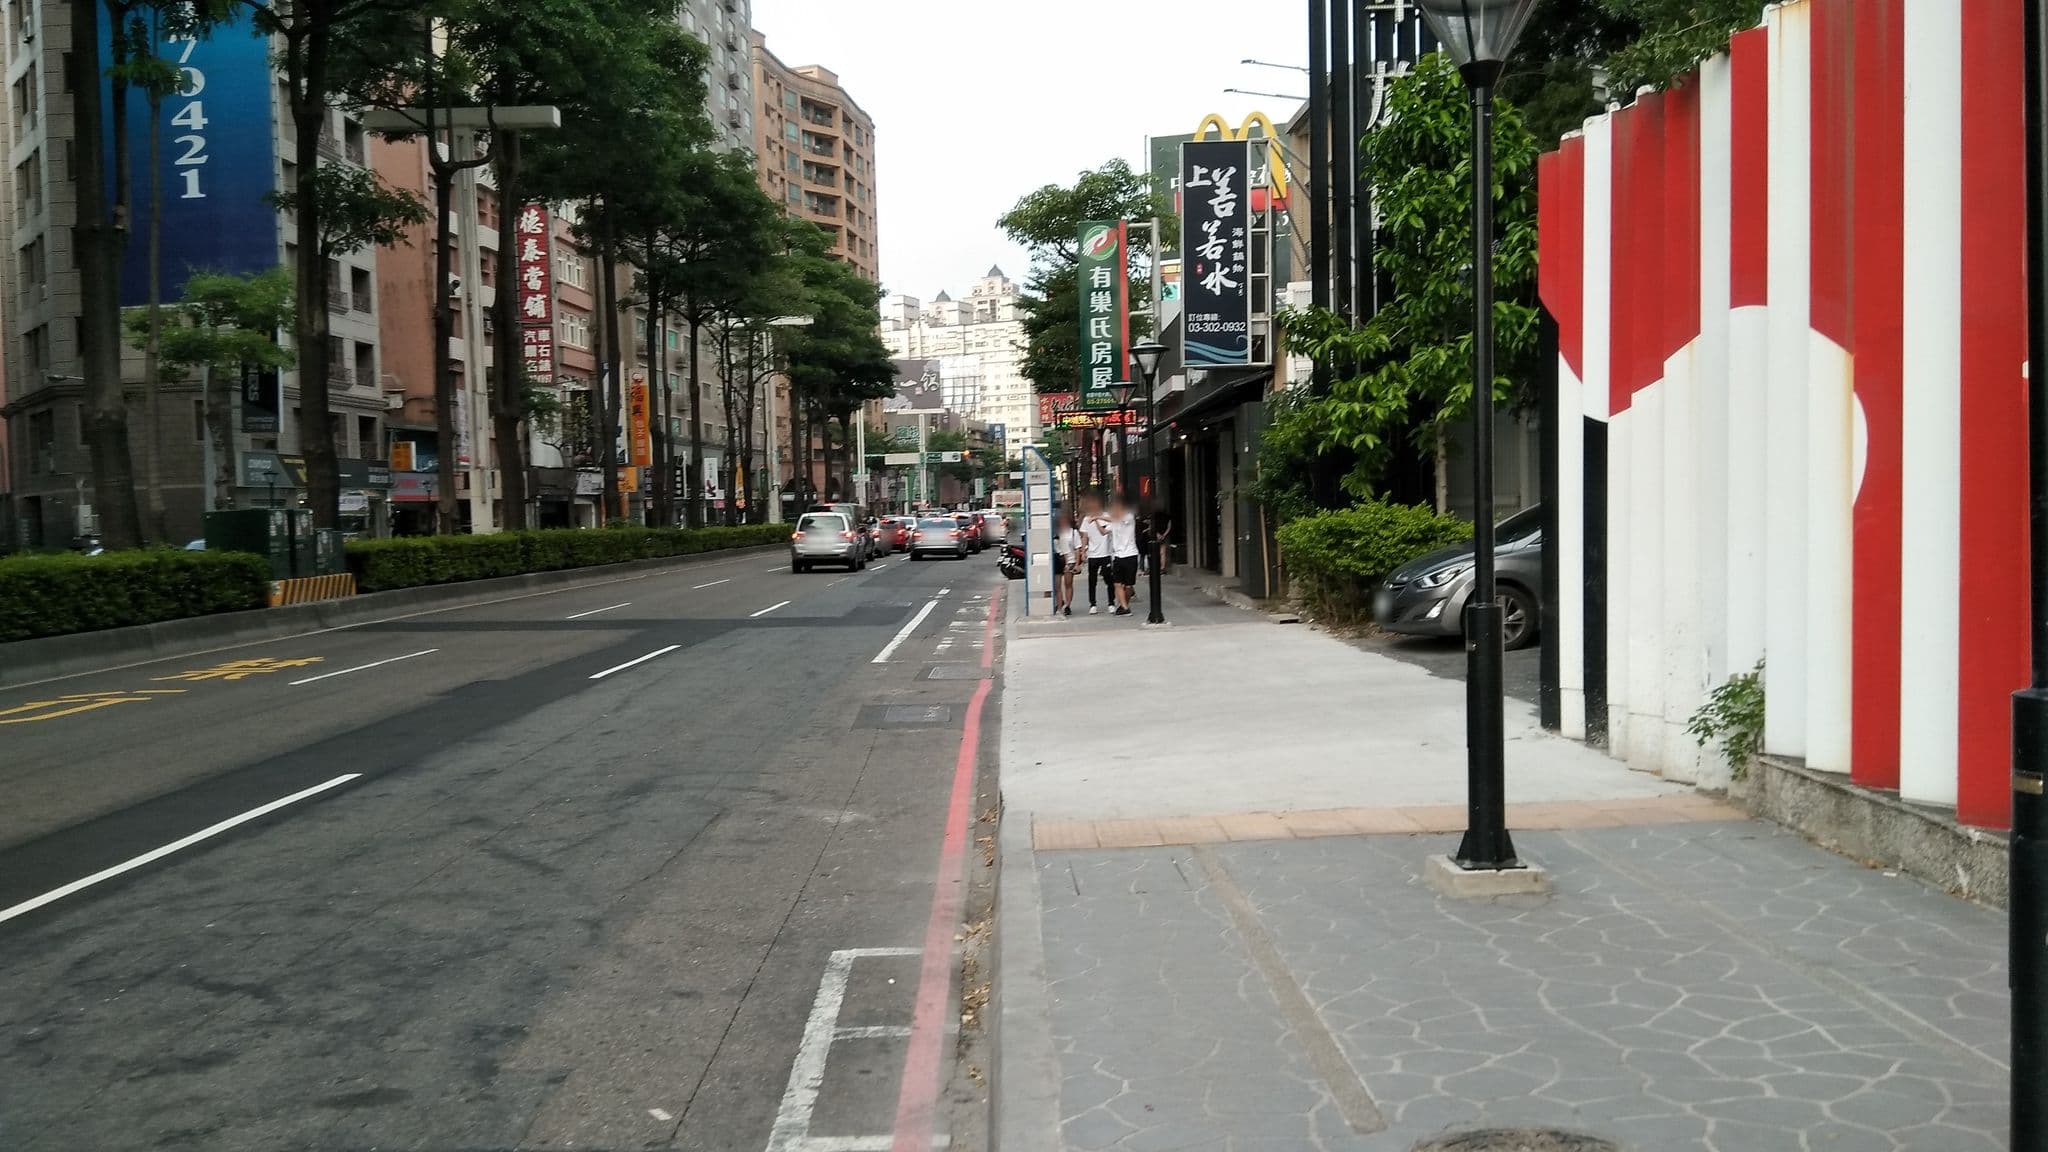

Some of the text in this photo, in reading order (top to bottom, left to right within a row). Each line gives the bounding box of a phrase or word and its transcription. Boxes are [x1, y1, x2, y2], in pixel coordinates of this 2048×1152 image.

[1185, 165, 1238, 296] 上善若水
[1089, 266, 1113, 390] 有巢氏房屋
[1187, 322, 1247, 333] 03-302-0932
